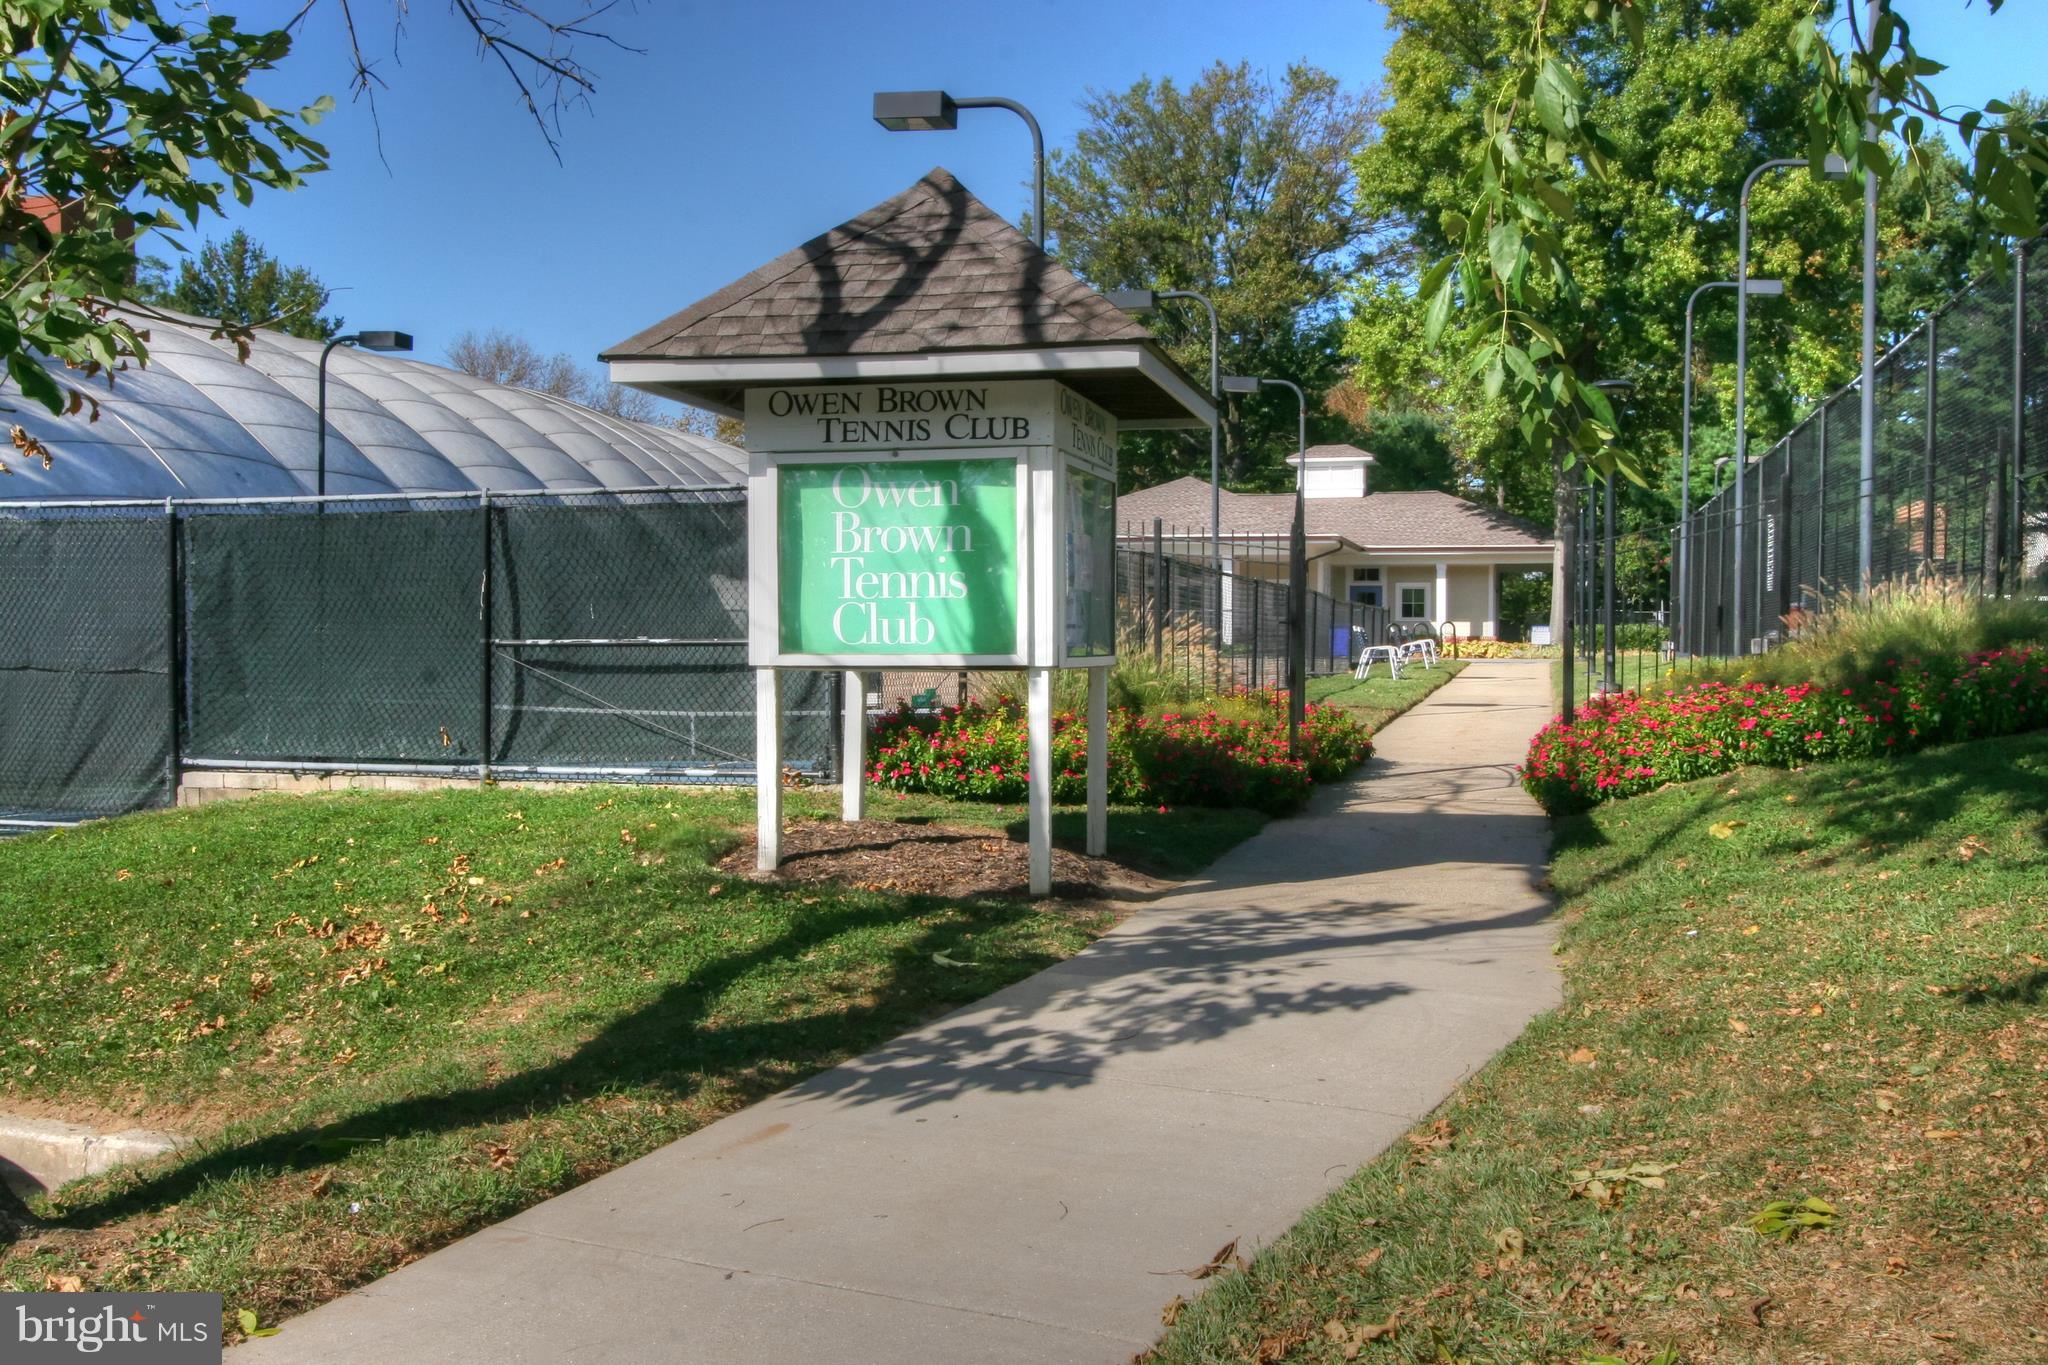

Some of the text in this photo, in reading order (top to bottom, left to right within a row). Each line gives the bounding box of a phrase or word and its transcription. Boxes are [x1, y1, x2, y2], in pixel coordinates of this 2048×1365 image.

[769, 387, 988, 416] OWEN BROWN
[817, 414, 1030, 443] TENNIS CLUB
[832, 464, 960, 509] Owen
[830, 511, 975, 554] Brown
[830, 556, 968, 600] Tennis
[832, 601, 936, 645] Club
